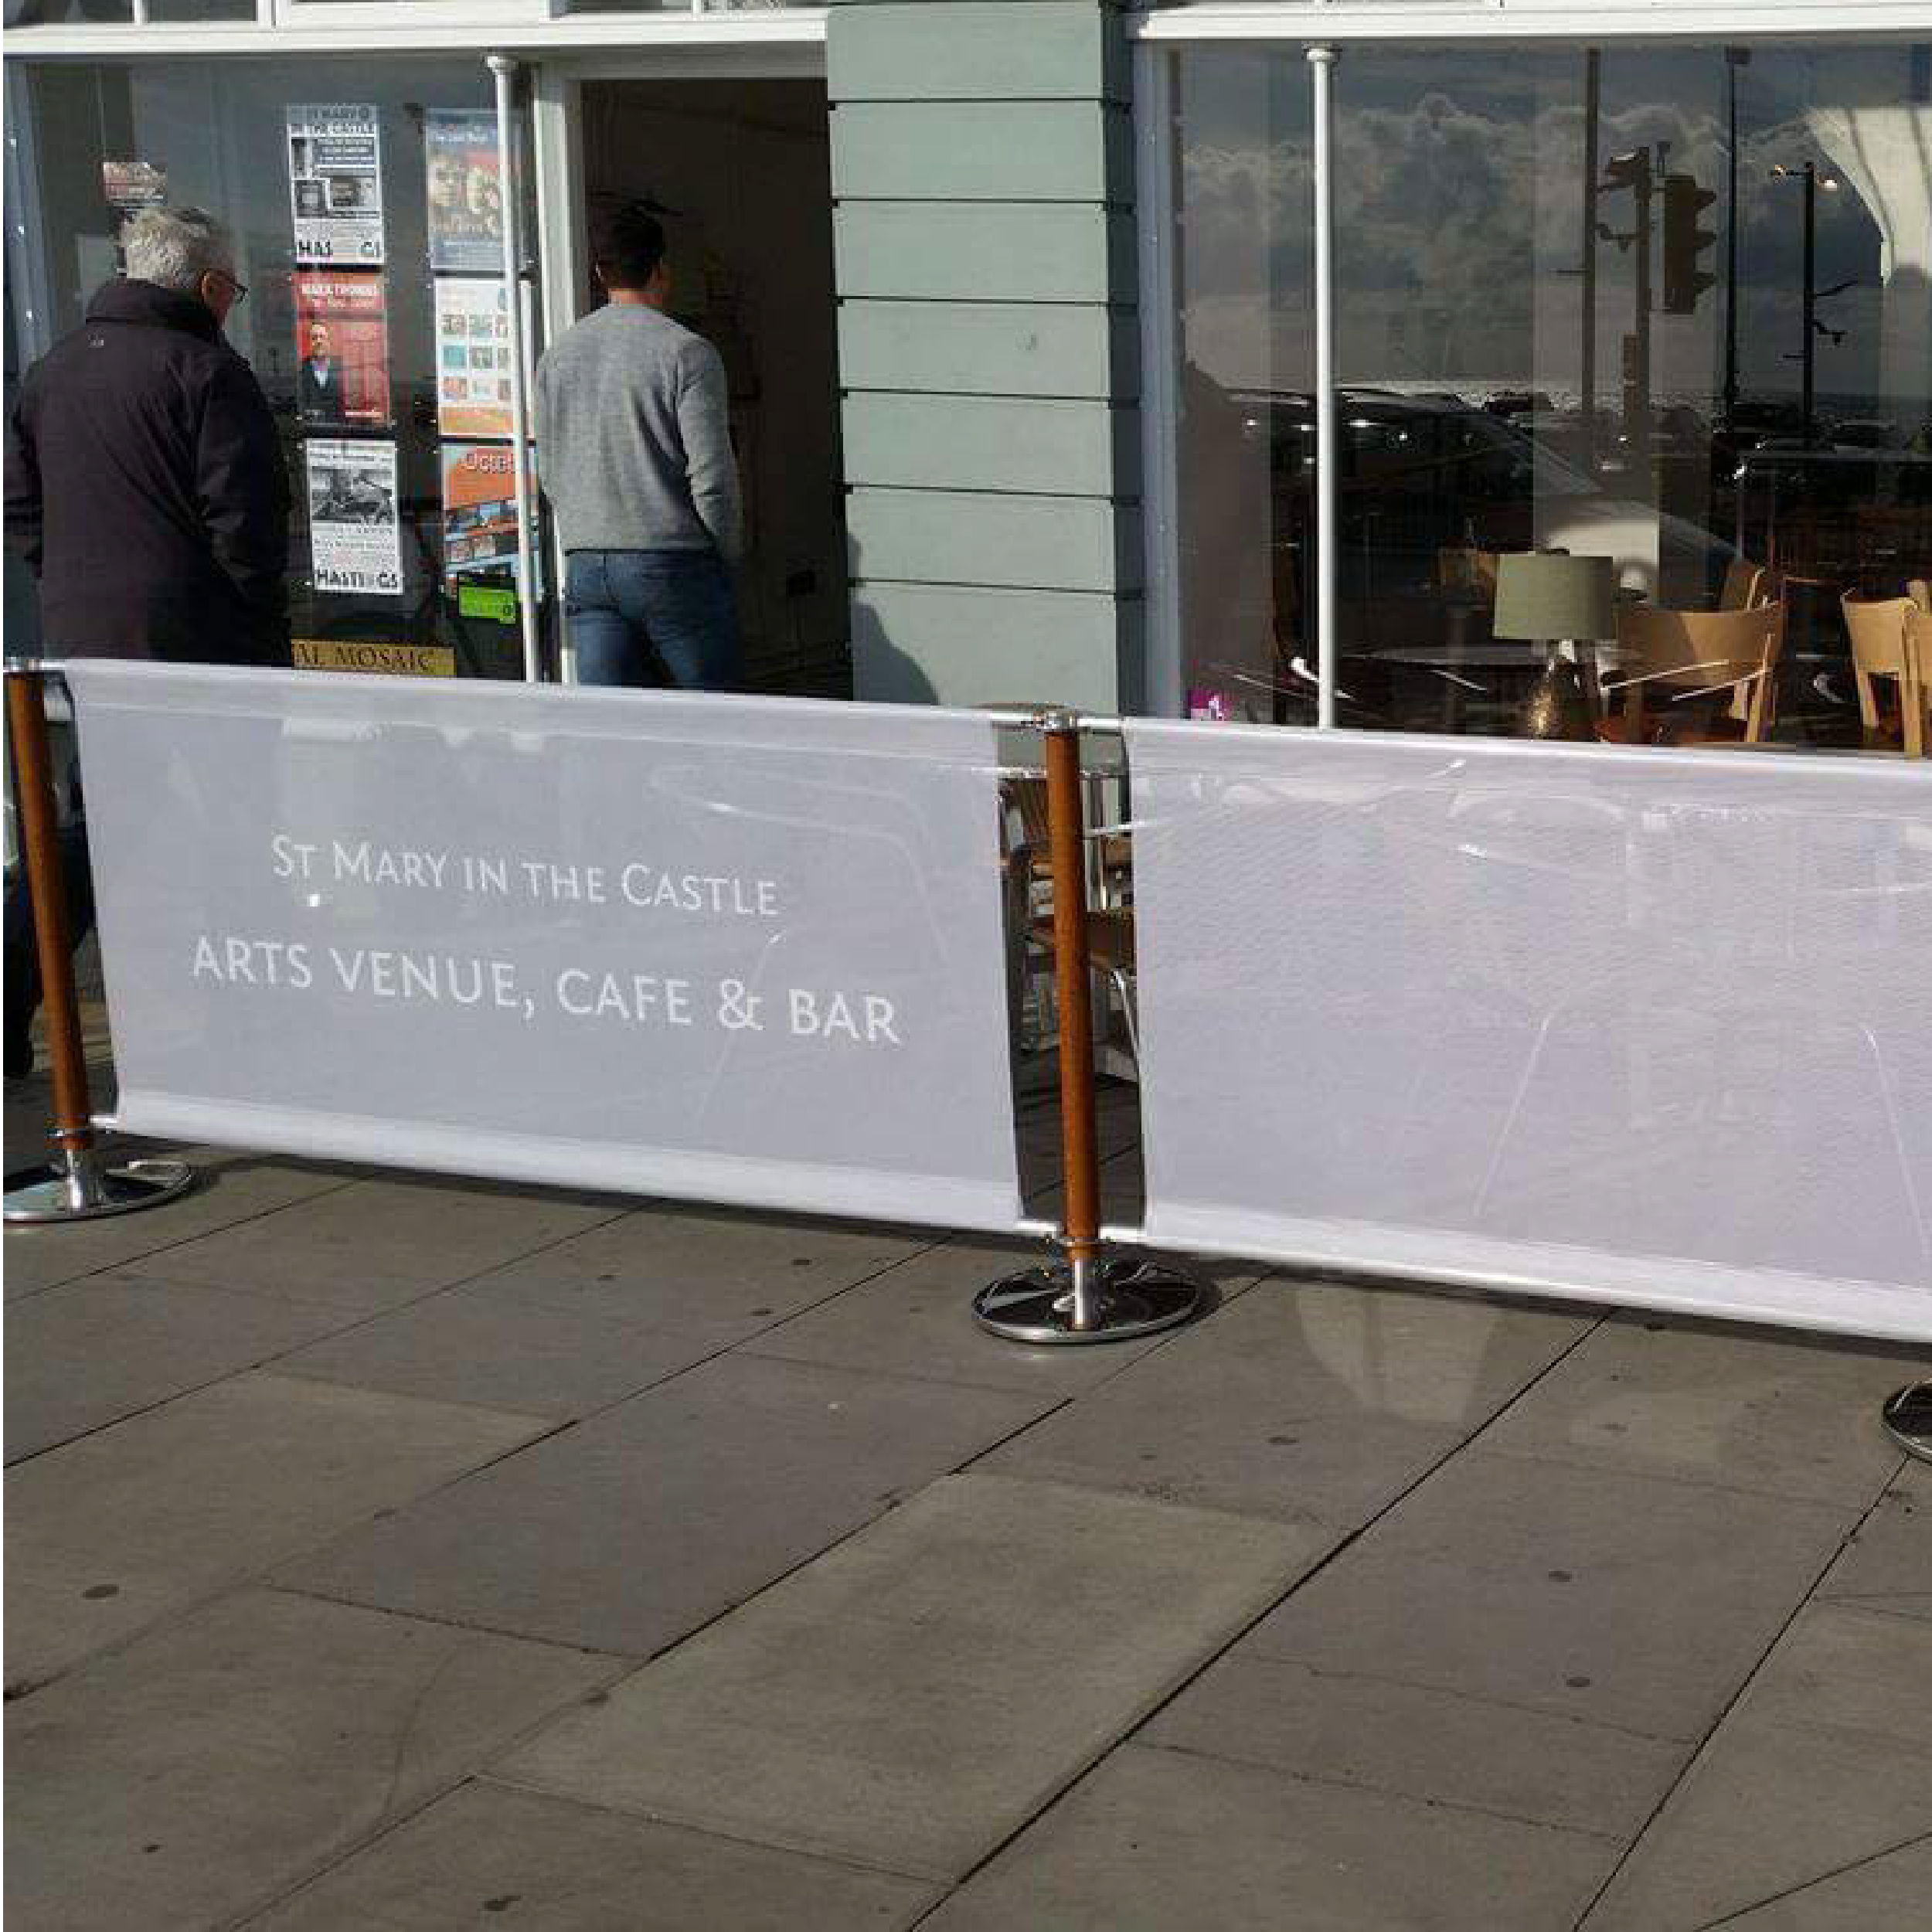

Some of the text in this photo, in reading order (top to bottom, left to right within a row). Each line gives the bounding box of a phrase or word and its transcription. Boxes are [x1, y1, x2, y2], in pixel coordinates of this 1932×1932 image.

[335, 646, 435, 672] MOSAIC
[332, 840, 447, 887] MARY
[463, 857, 508, 894] IN
[521, 862, 607, 903] THE
[621, 863, 779, 915] CASTLE
[192, 936, 901, 1044] ARTS VENUE, CAFE & BAR
